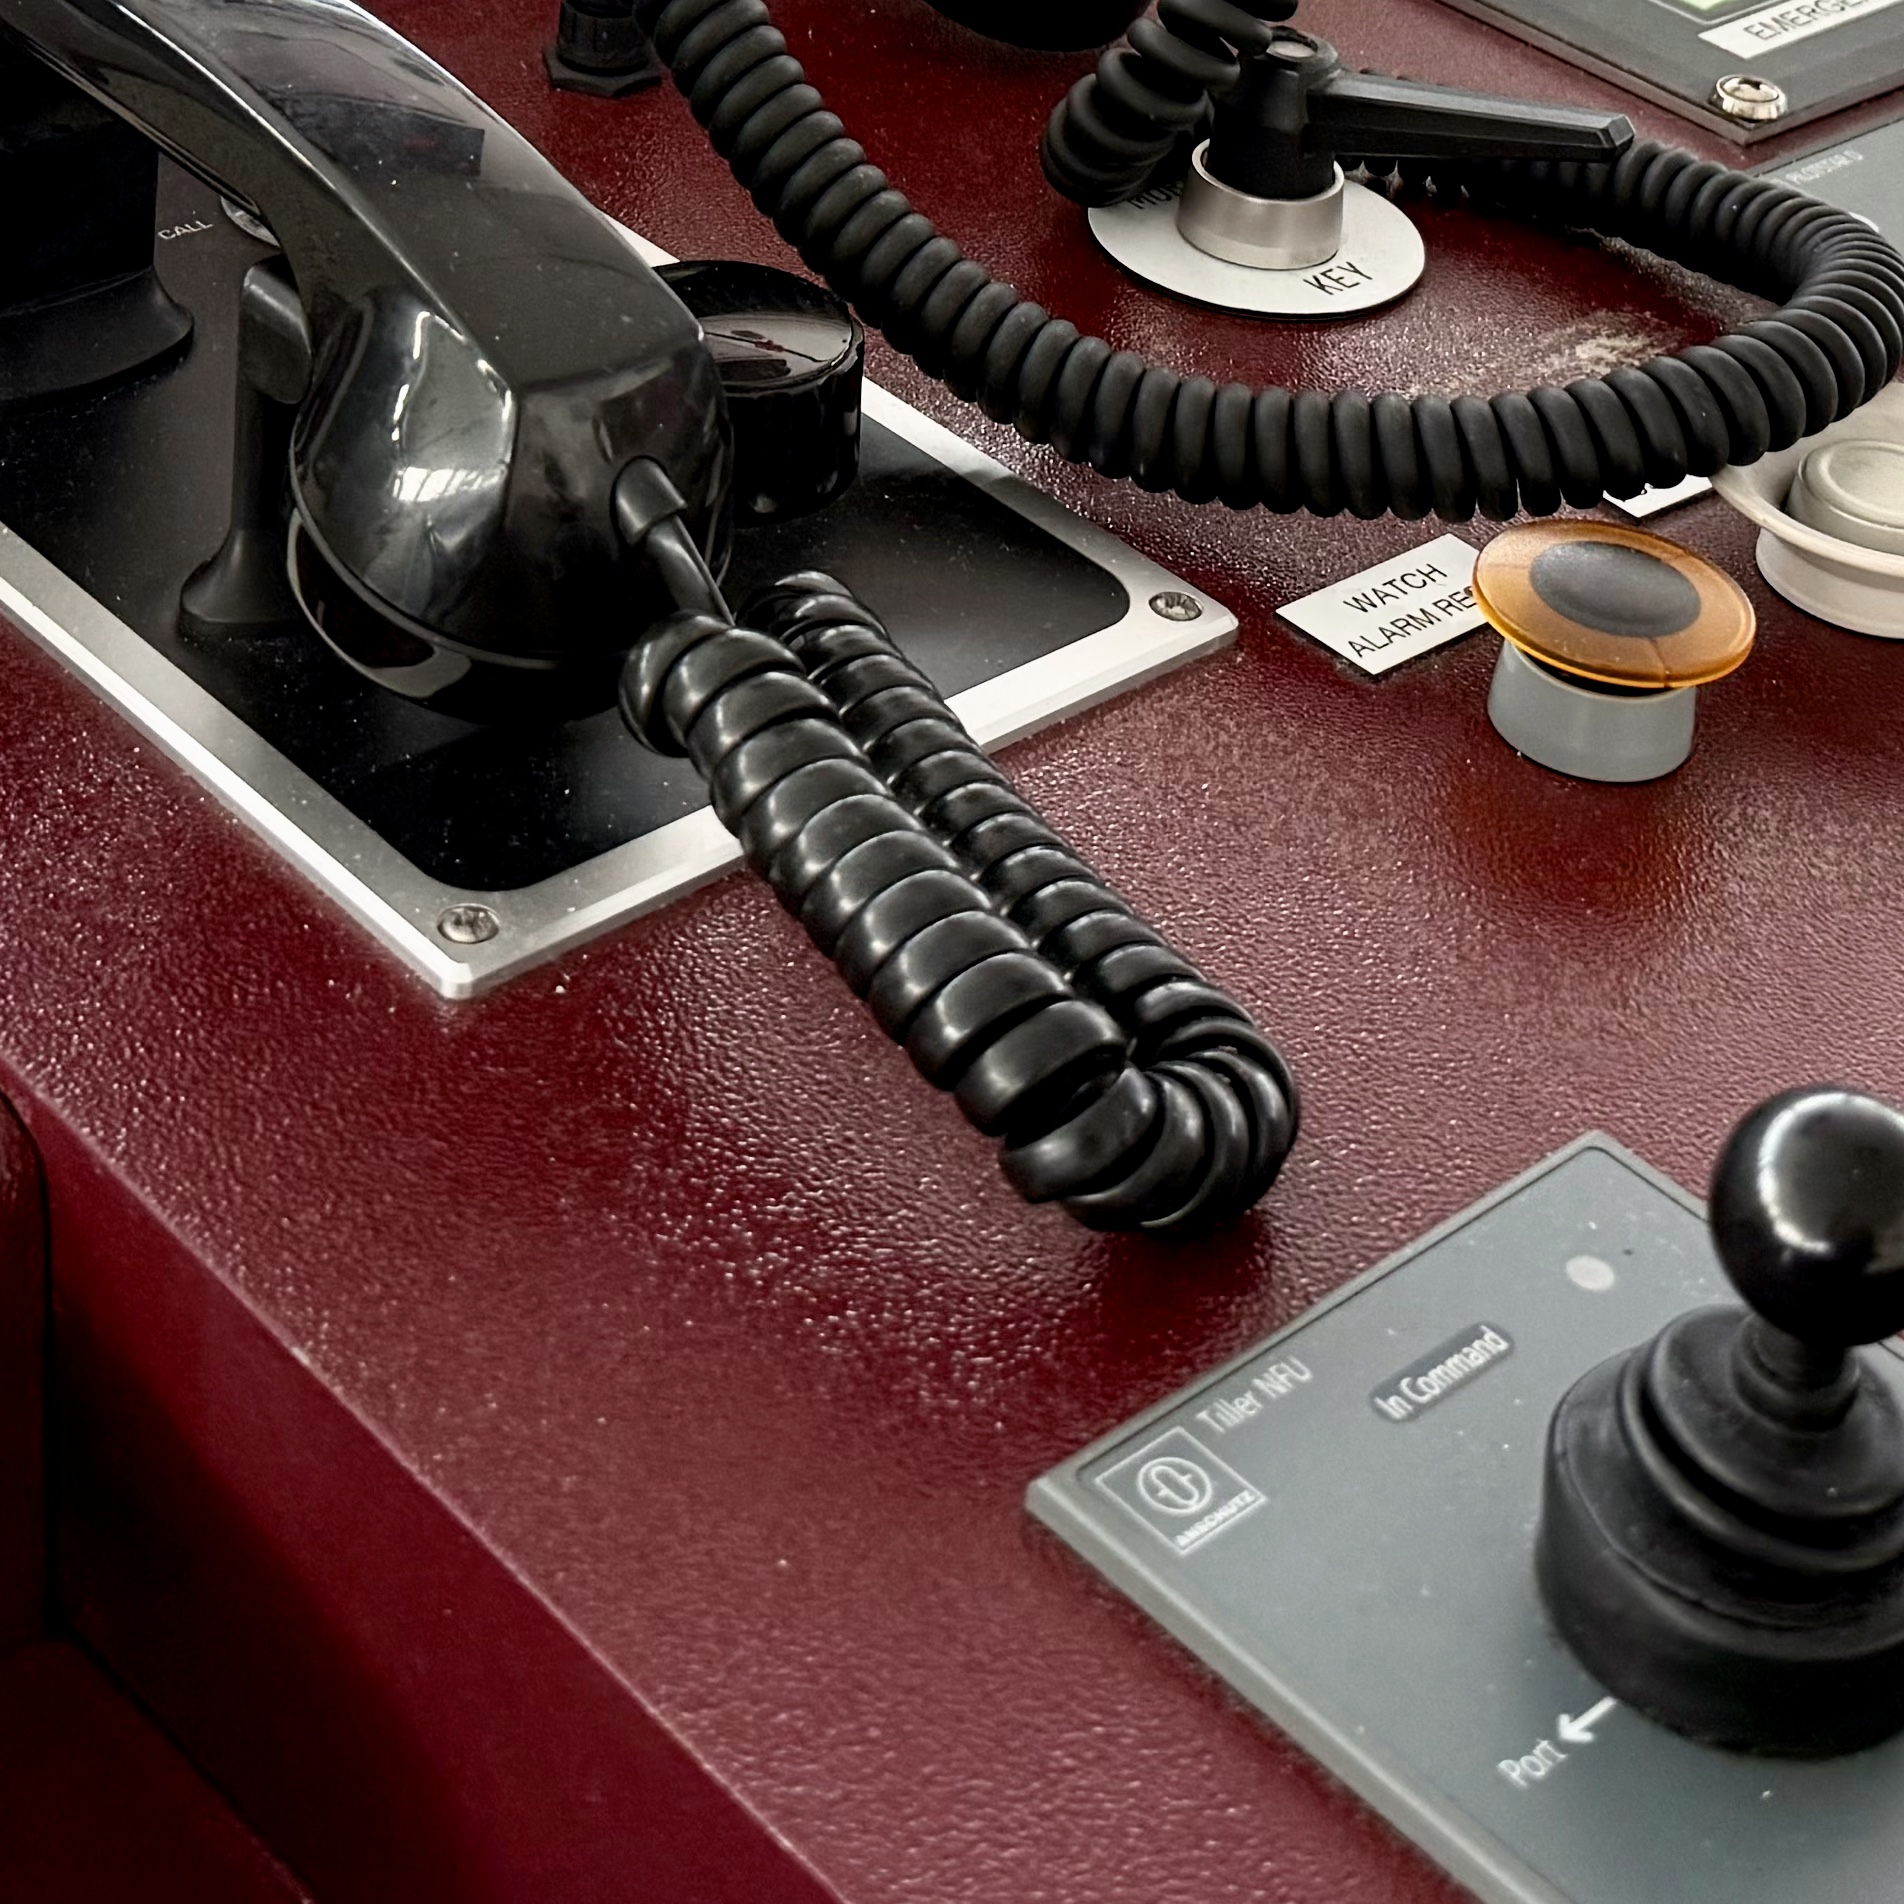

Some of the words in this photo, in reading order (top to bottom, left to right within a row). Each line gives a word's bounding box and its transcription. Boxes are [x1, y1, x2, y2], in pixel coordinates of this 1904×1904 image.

[1302, 260, 1374, 296] KEY
[1344, 562, 1448, 615] WATCH
[1348, 607, 1442, 659] ALARM
[1196, 1389, 1264, 1434] Tiller
[1253, 1355, 1313, 1401] NFU
[1375, 1396, 1408, 1420] In
[1400, 1325, 1509, 1405] Command
[1496, 1738, 1568, 1789] Port
